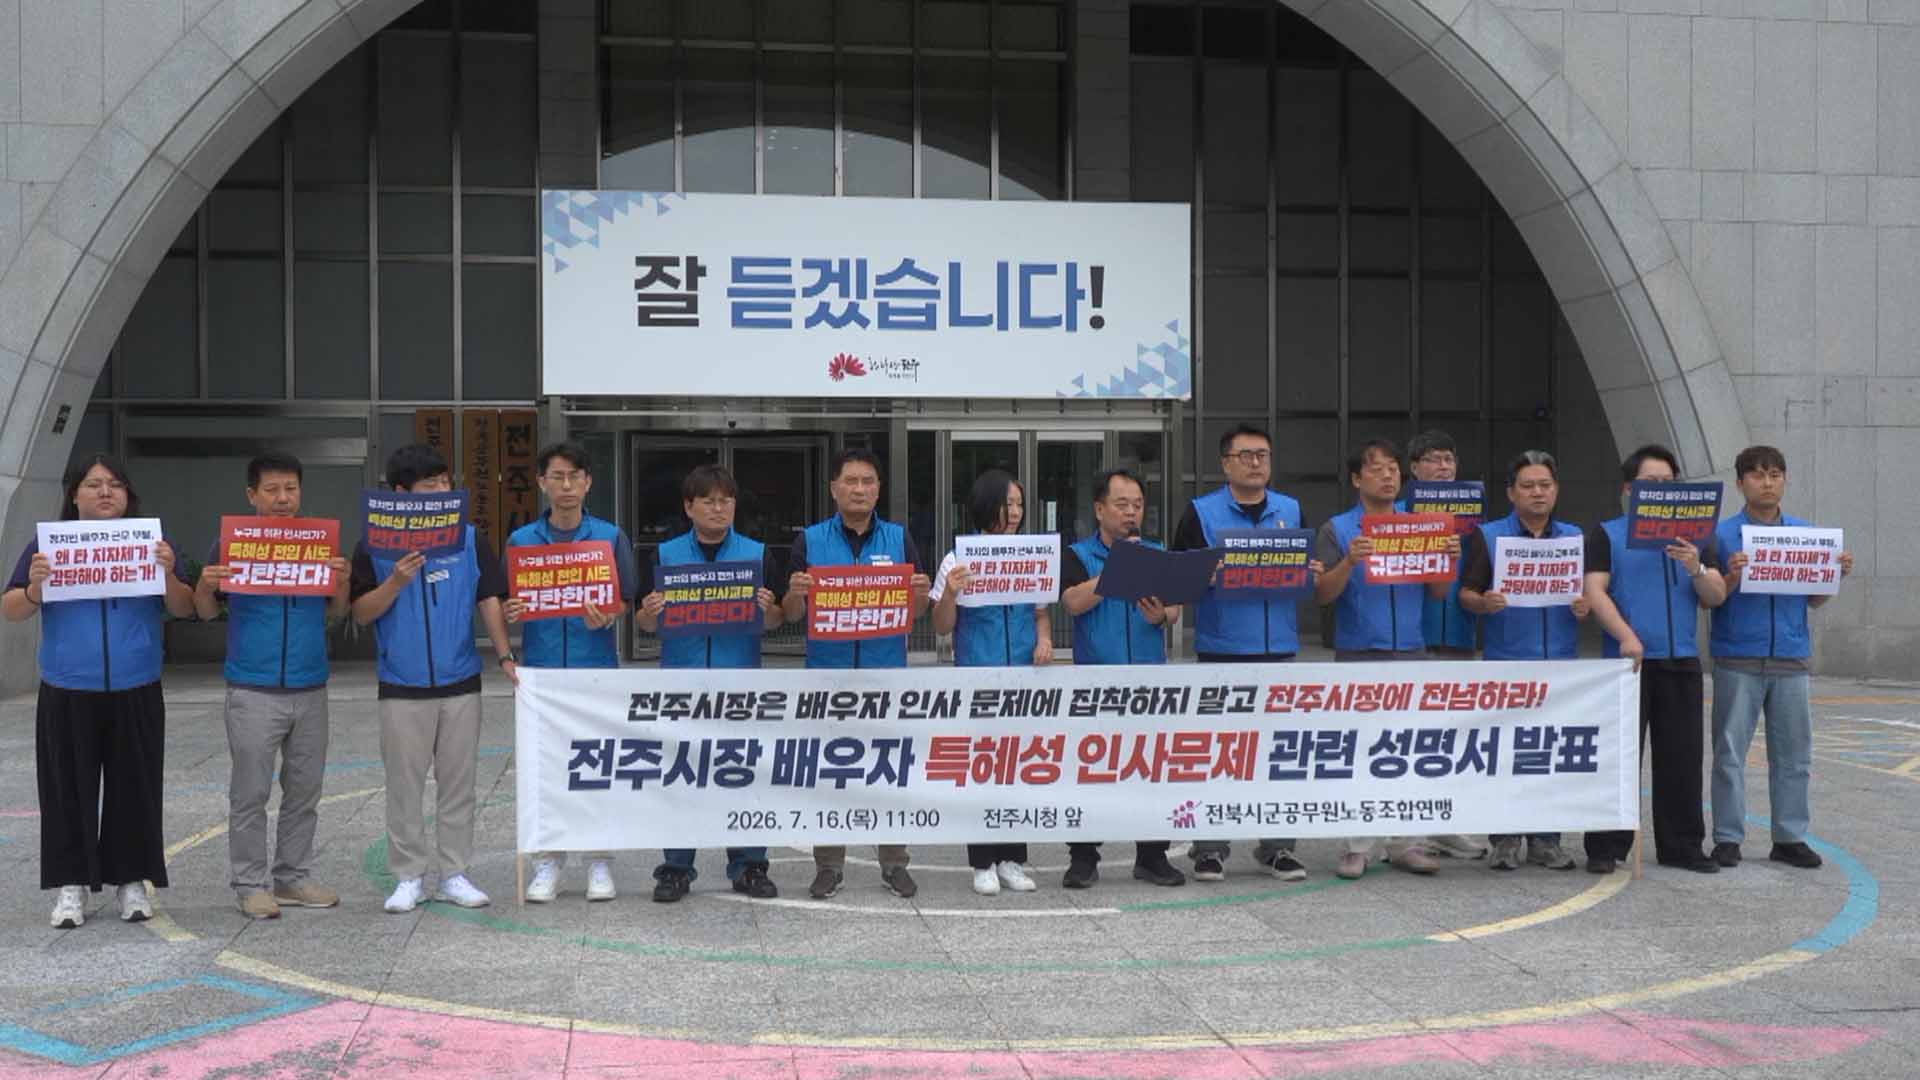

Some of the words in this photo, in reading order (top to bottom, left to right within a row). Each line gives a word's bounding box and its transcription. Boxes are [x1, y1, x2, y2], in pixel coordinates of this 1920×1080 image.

[634, 255, 707, 327] 잘
[726, 255, 1106, 332] 듣겠습니다!
[55, 548, 69, 566] 왜
[74, 548, 88, 564] 타
[228, 542, 270, 560] 특혜성
[273, 543, 301, 560] 전입
[303, 544, 331, 560] 시도
[1755, 549, 1768, 563] 왜
[110, 563, 156, 583] 하는가!
[228, 561, 331, 585] 규탄한다!
[516, 570, 554, 587] 특혜성
[557, 567, 582, 585] 전입
[586, 565, 610, 582] 시도
[985, 560, 997, 575] 타
[1370, 553, 1450, 577] 규탄한다!
[1013, 576, 1054, 593] 하는가!
[815, 590, 852, 608] 특혜성
[855, 590, 880, 608] 전입
[883, 589, 908, 606] 시도
[815, 607, 909, 632] 규탄한다!
[627, 690, 787, 722] 전주시장은
[795, 689, 890, 721] 배우자
[898, 689, 961, 719] 인사
[969, 688, 1062, 719] 문제에
[1068, 685, 1191, 717] 집착하지
[1196, 684, 1258, 715] 말고
[1264, 681, 1414, 713] 전주시정에
[1418, 681, 1548, 712] 전념하라!
[567, 737, 763, 791] 전주시장
[770, 736, 915, 790] 배우자
[924, 734, 1066, 788] 특혜성
[1076, 730, 1260, 785] 인사문제
[1268, 729, 1358, 781] 관련
[1368, 726, 1501, 780] 성명서
[1512, 725, 1600, 776] 발표
[726, 810, 783, 831] 2026.
[789, 810, 807, 830] 7.
[815, 807, 879, 831] 16.(목)
[885, 808, 940, 829] 11:00
[983, 806, 1057, 829] 전주시청
[1065, 806, 1083, 828] 앞
[1205, 798, 1453, 826] 전북시군공무원노동조합연맹
